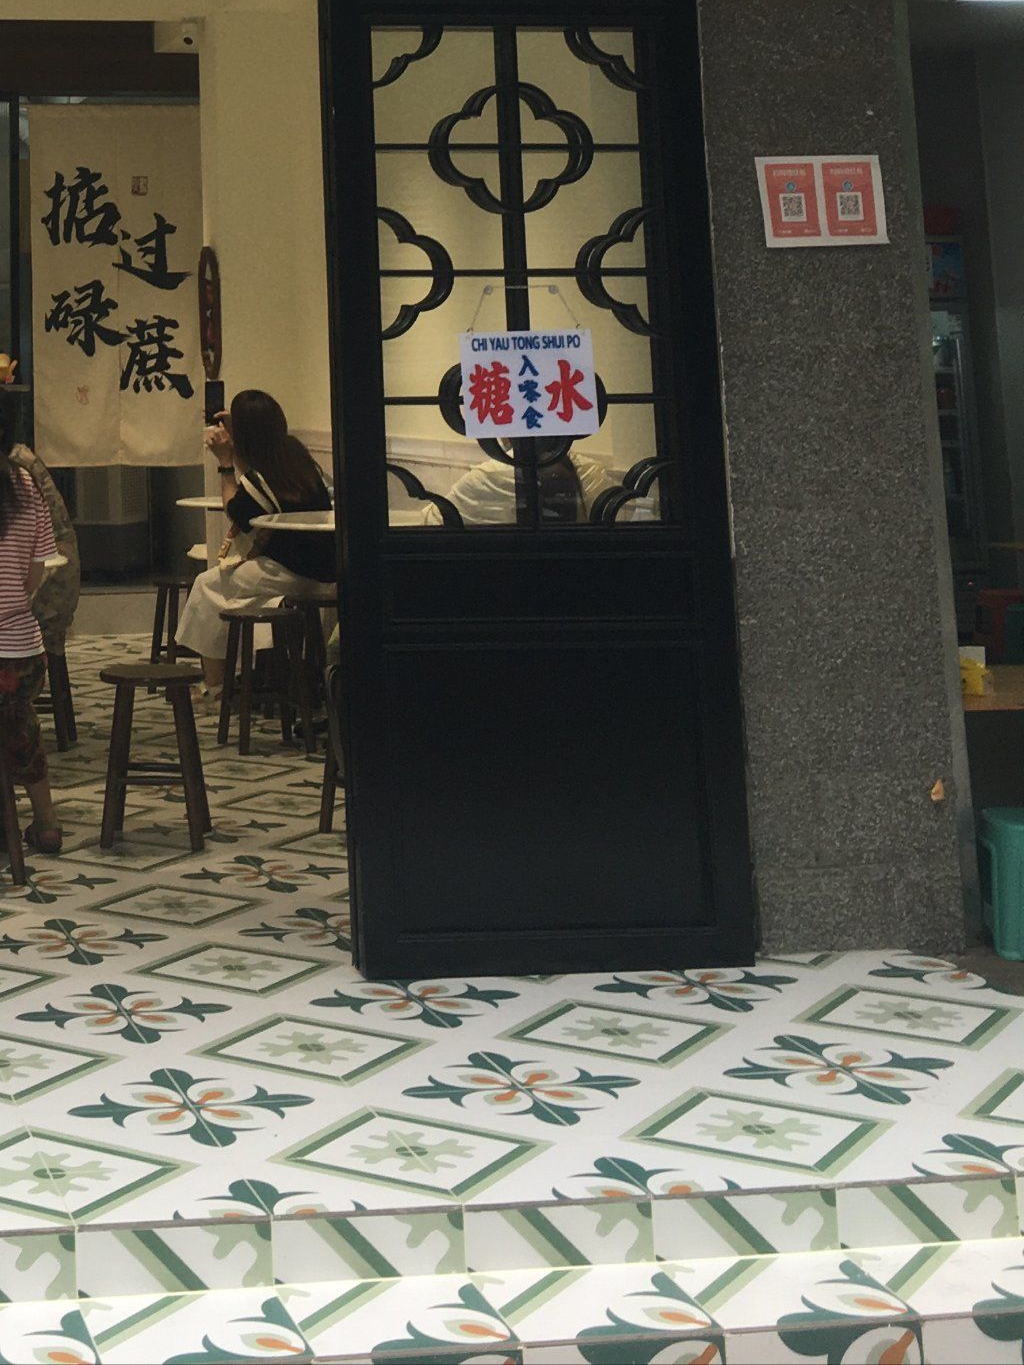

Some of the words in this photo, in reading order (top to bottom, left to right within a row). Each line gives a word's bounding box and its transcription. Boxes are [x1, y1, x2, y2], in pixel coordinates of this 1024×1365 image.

[471, 338, 488, 352] CHI
[489, 336, 510, 351] YAU
[511, 335, 540, 350] TONG
[542, 334, 565, 349] SHUI
[566, 334, 581, 348] PO
